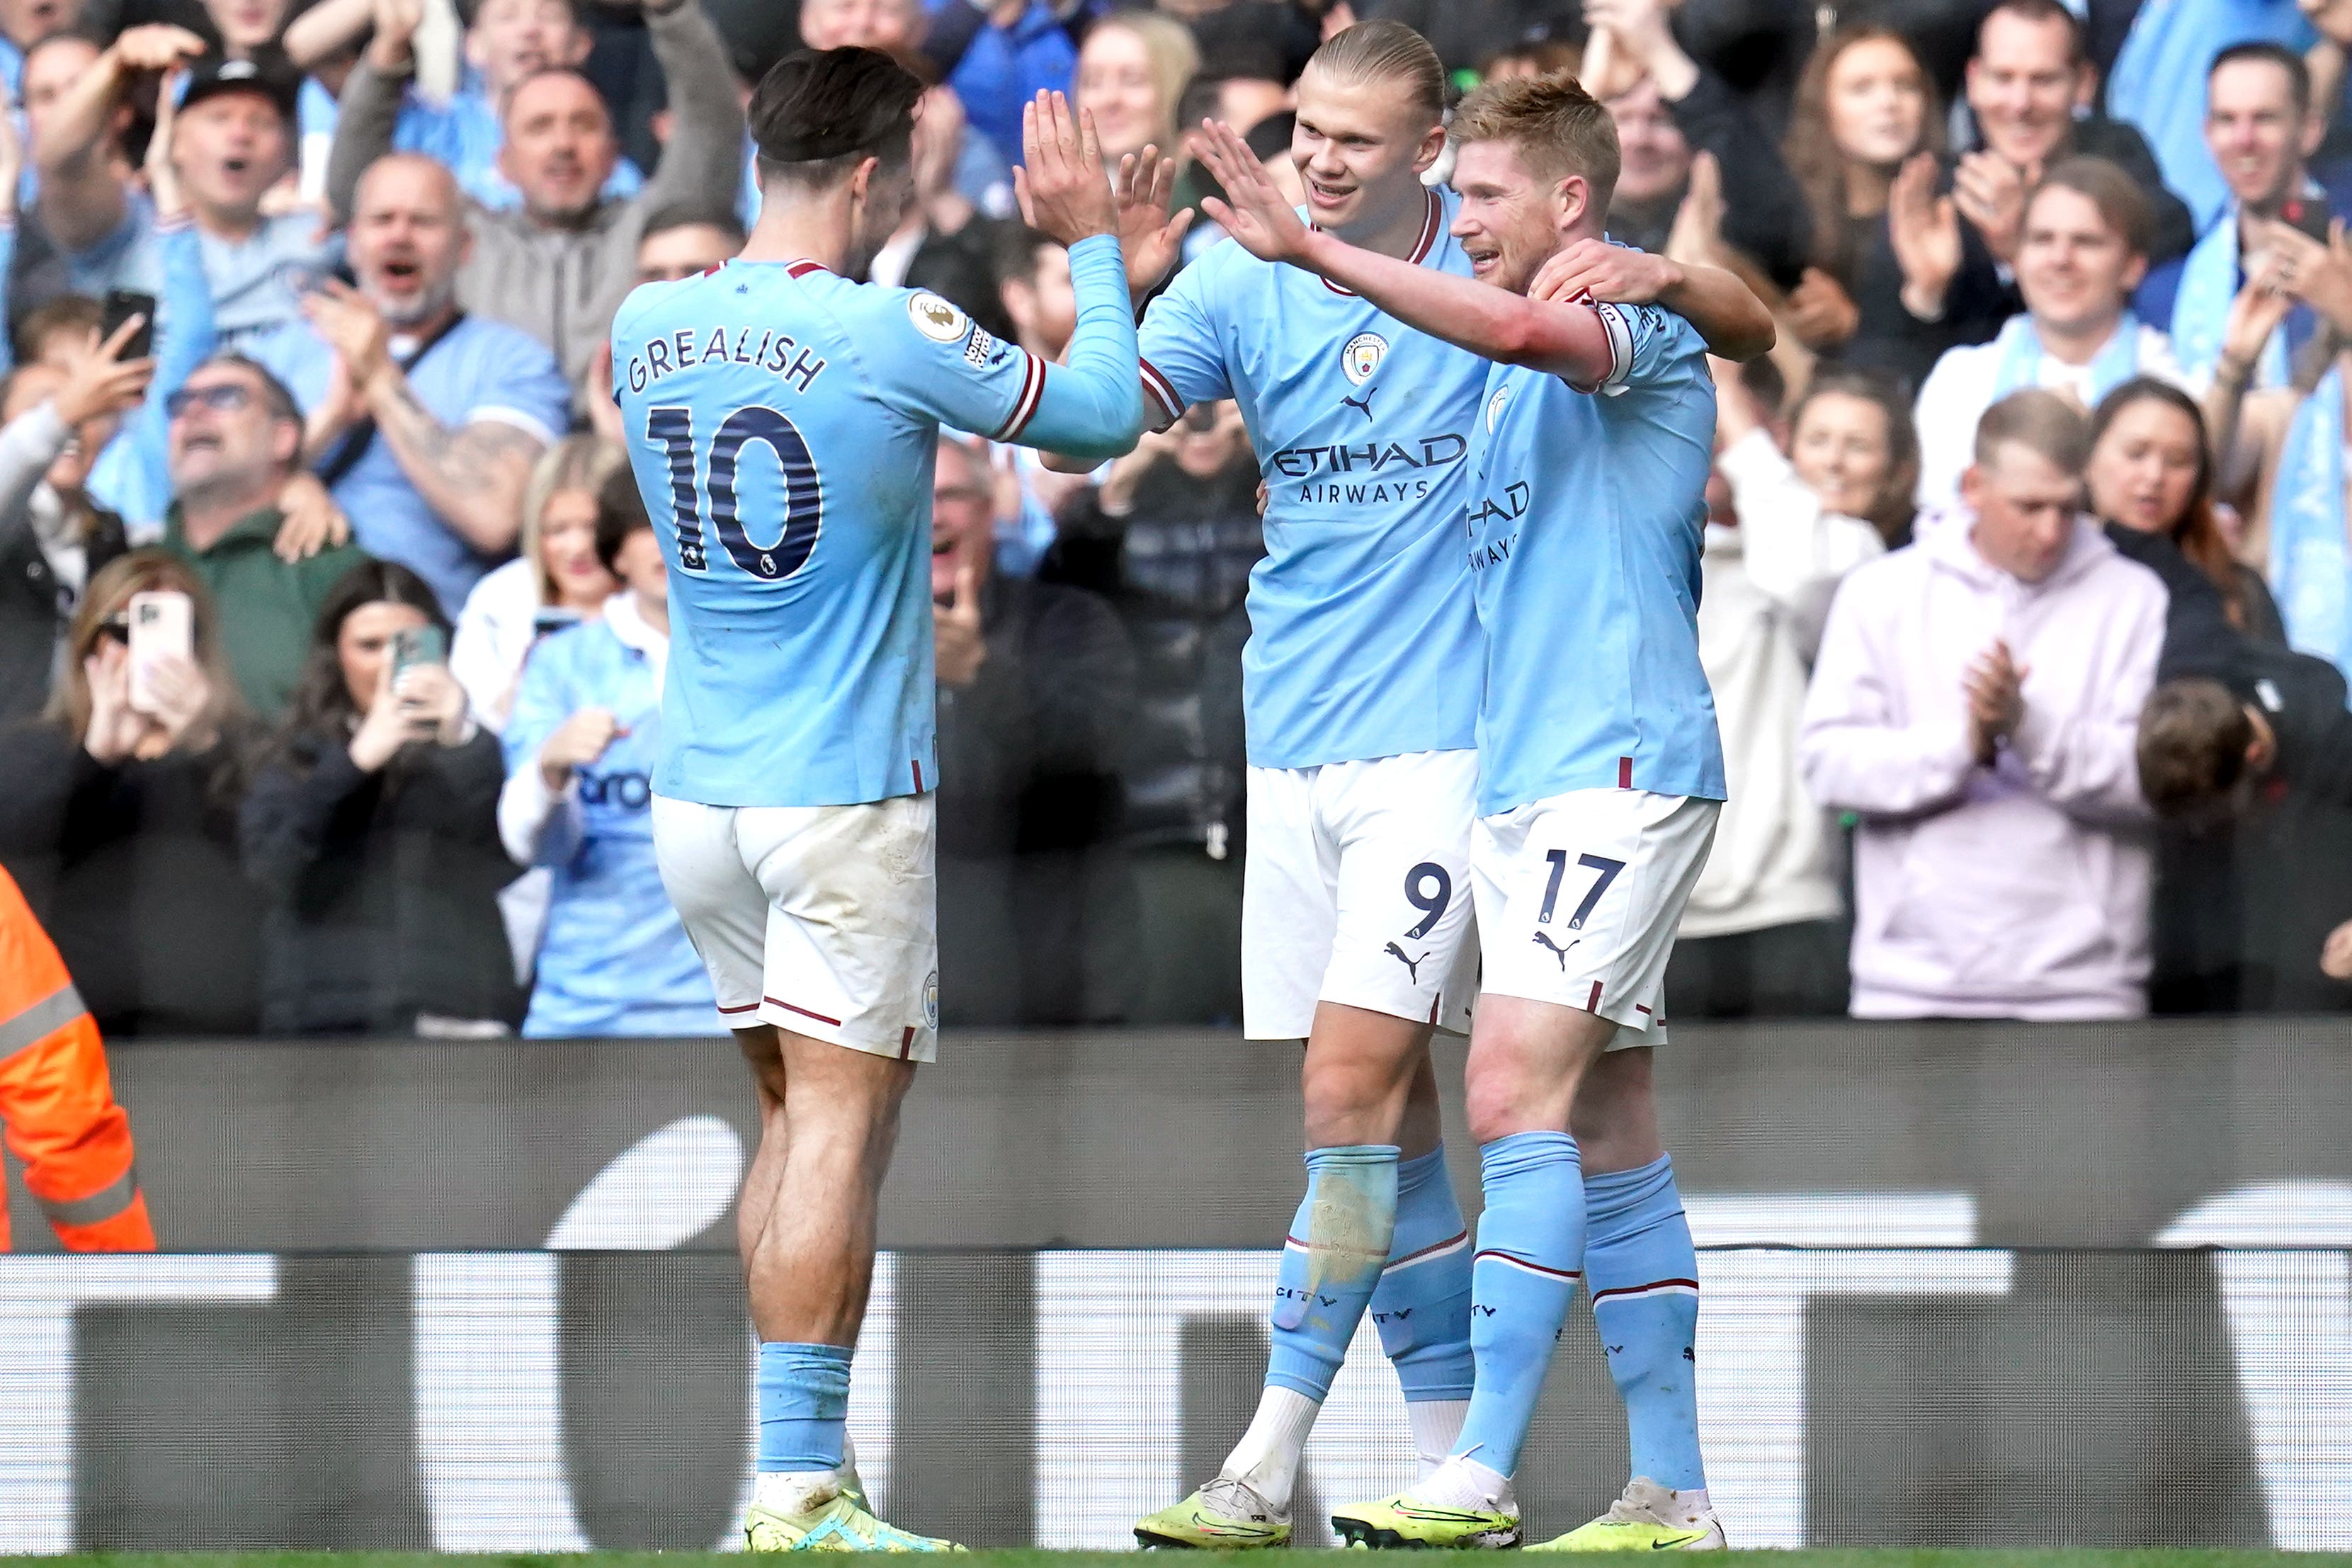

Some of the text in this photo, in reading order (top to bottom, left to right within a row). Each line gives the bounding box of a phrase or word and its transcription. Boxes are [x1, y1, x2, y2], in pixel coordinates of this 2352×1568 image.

[629, 328, 825, 393] GREALISH
[1273, 433, 1467, 477] ETIHAD
[646, 405, 822, 581] 10
[1300, 480, 1428, 504] AIRWAYS
[1403, 861, 1452, 940] 9
[1538, 848, 1627, 931] 17
[1276, 1286, 1337, 1307] CITY
